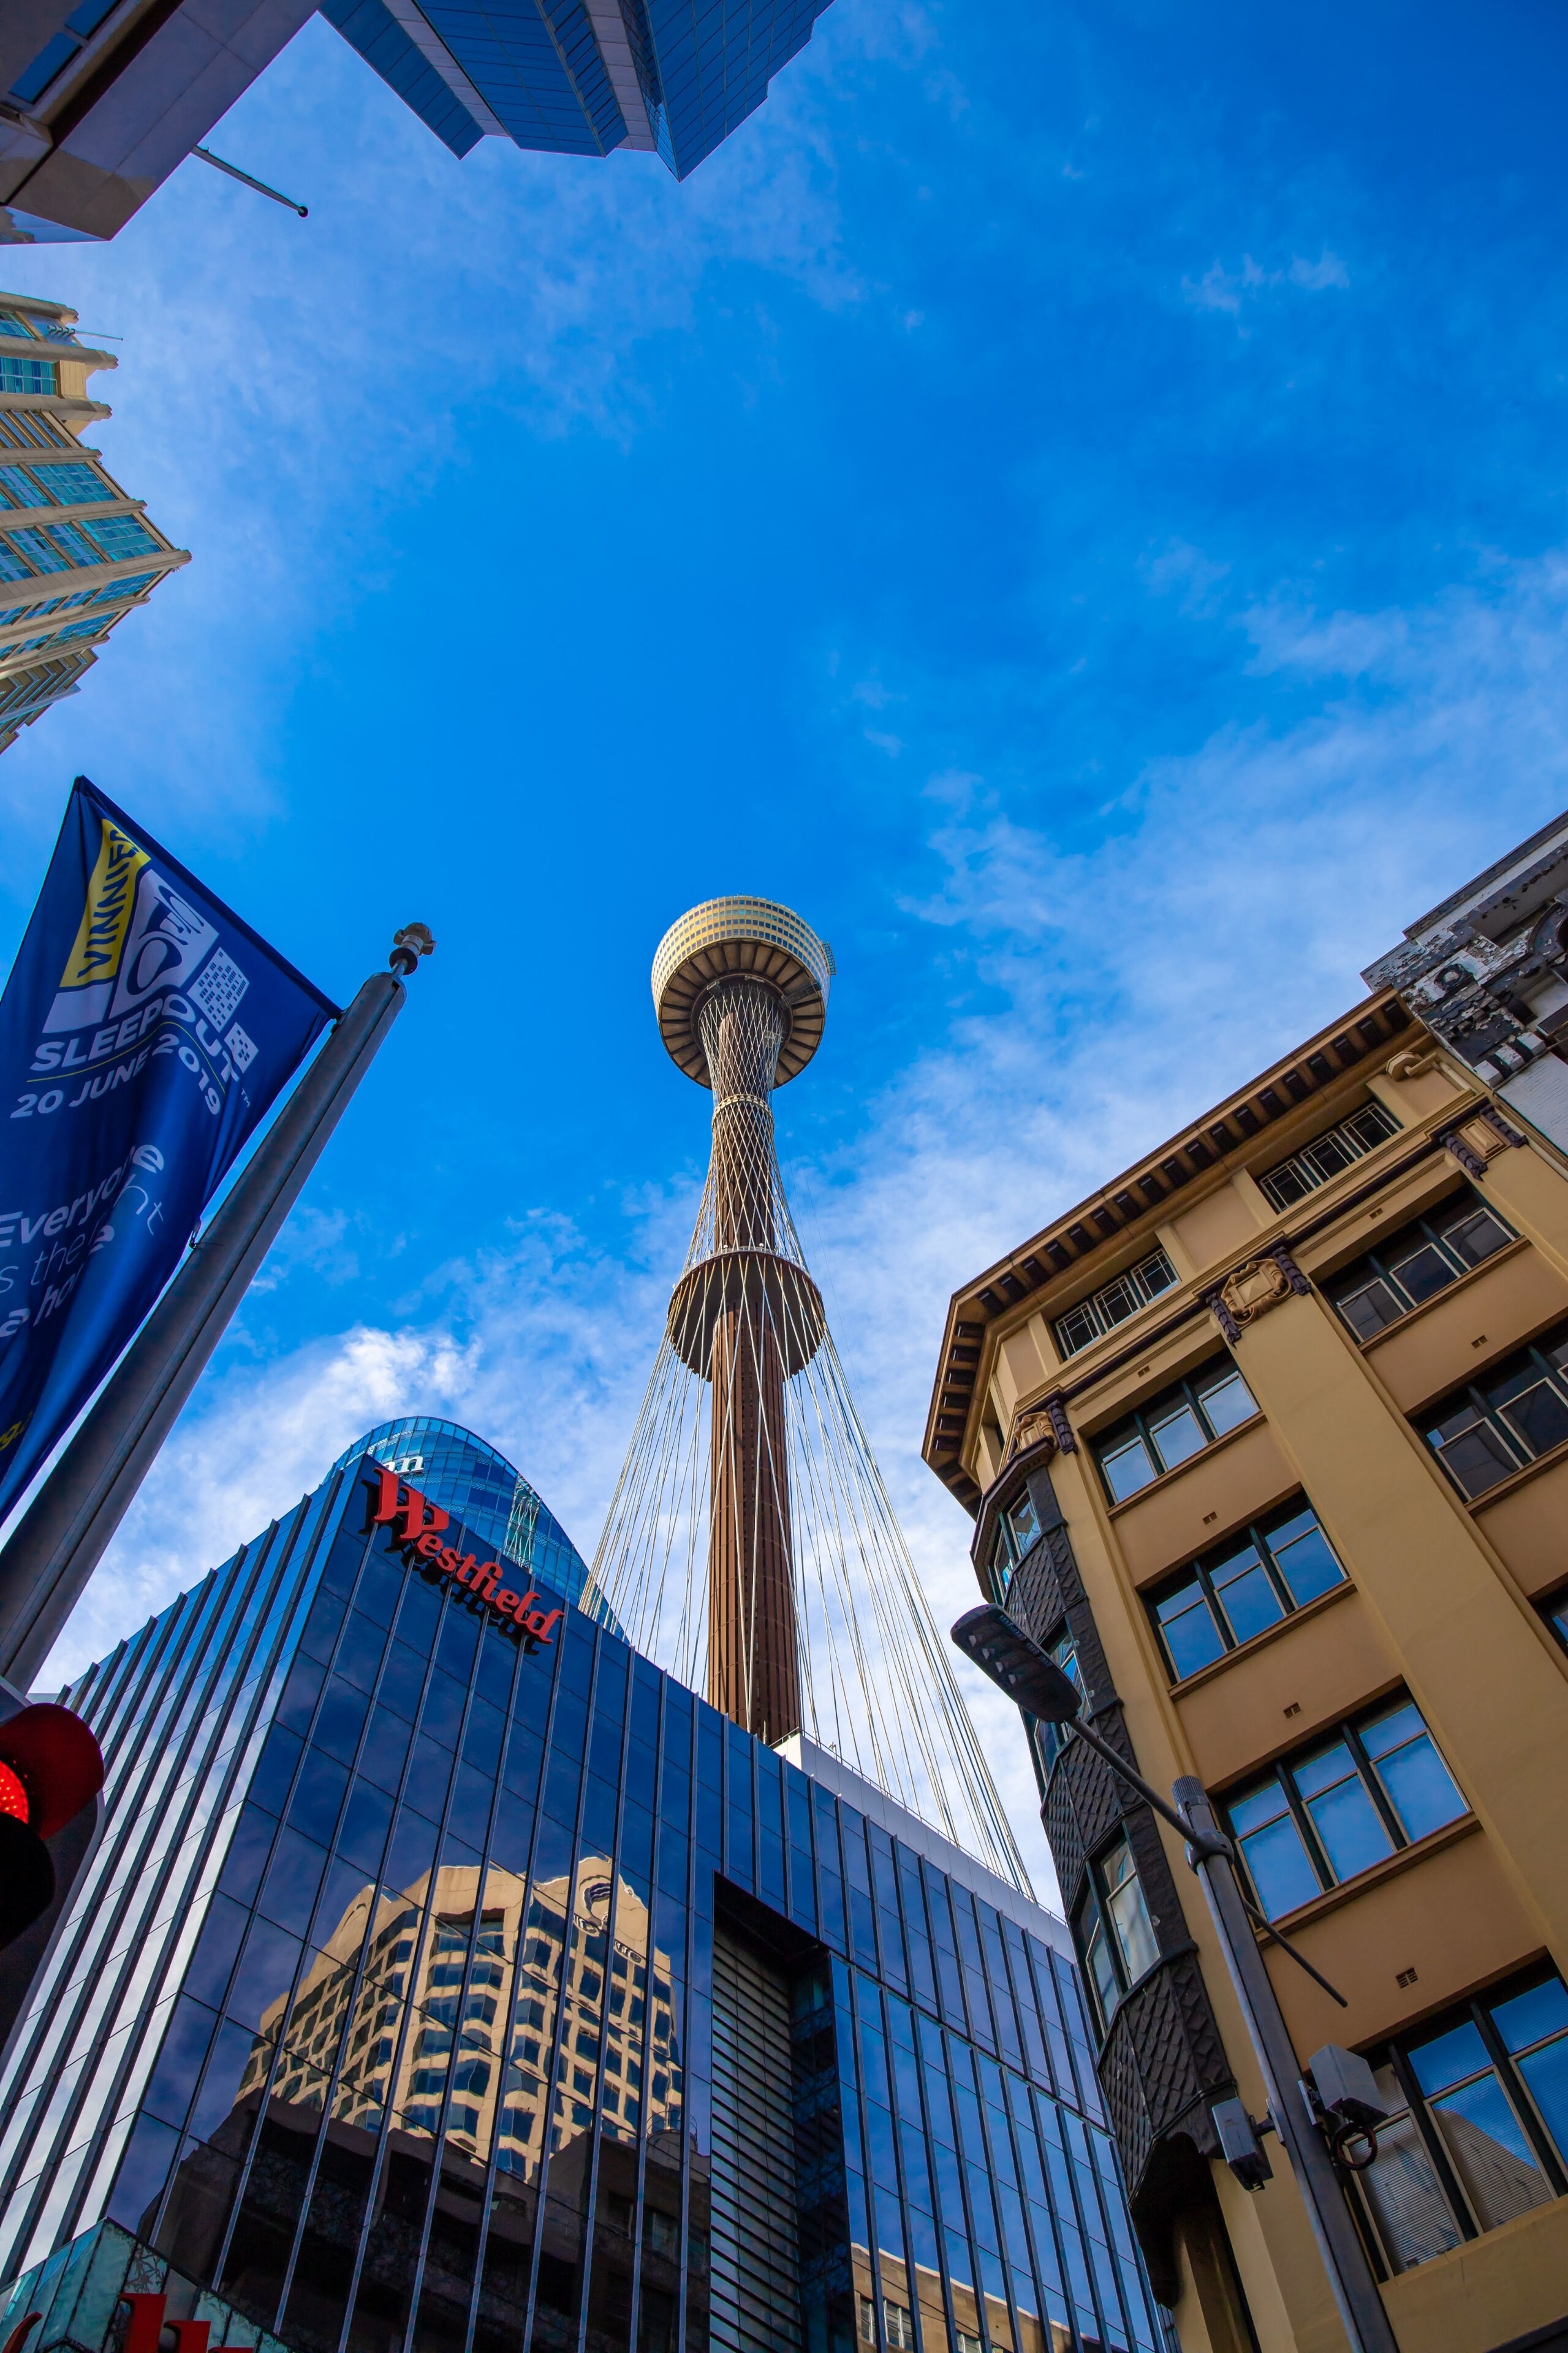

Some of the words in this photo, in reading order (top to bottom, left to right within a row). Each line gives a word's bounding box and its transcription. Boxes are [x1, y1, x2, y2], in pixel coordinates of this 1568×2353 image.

[77, 829, 140, 979] VINNIES
[10, 1089, 64, 1118] 20
[69, 1044, 152, 1107] JUNE
[152, 1034, 221, 1115] 2019
[29, 994, 240, 1082] SLEEPOUT
[31, 1233, 85, 1286] the
[371, 1467, 565, 1645] Westfield
